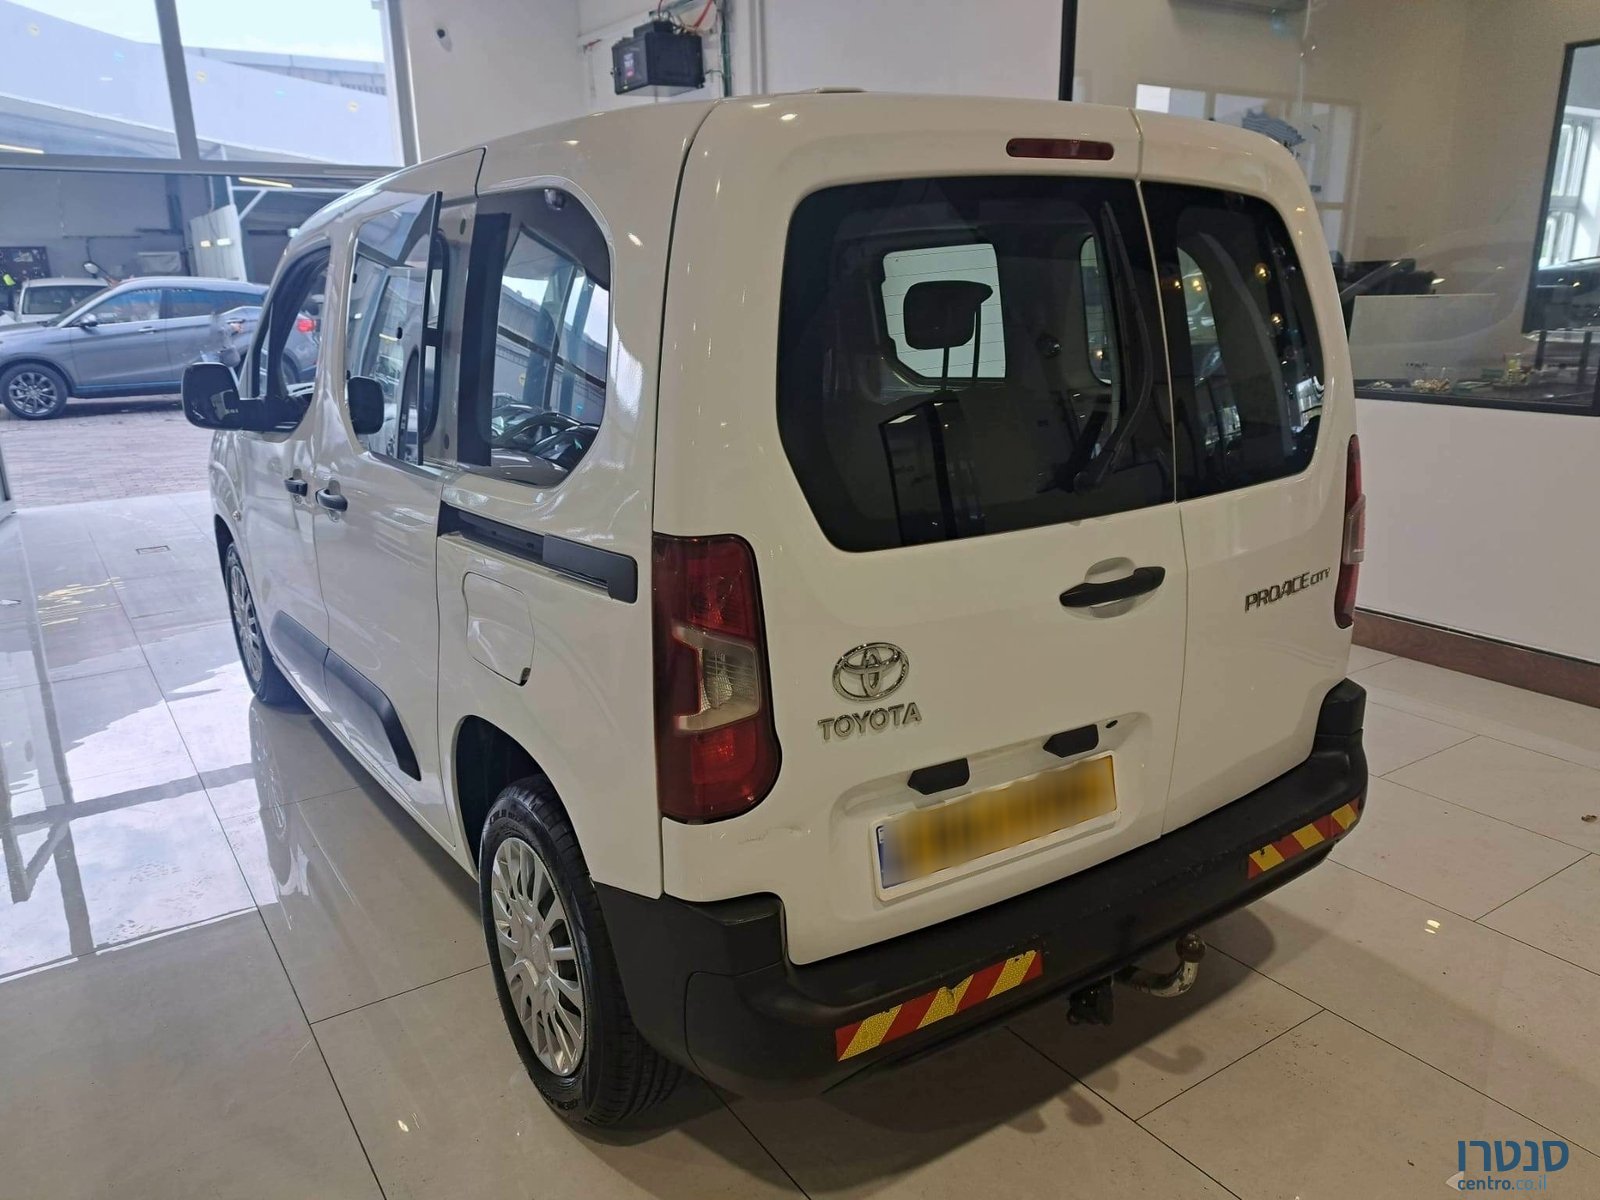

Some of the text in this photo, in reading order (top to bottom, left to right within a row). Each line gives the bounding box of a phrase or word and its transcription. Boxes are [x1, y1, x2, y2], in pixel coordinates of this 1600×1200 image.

[1245, 567, 1331, 613] PROACE CITY
[817, 702, 922, 741] TOYOTA
